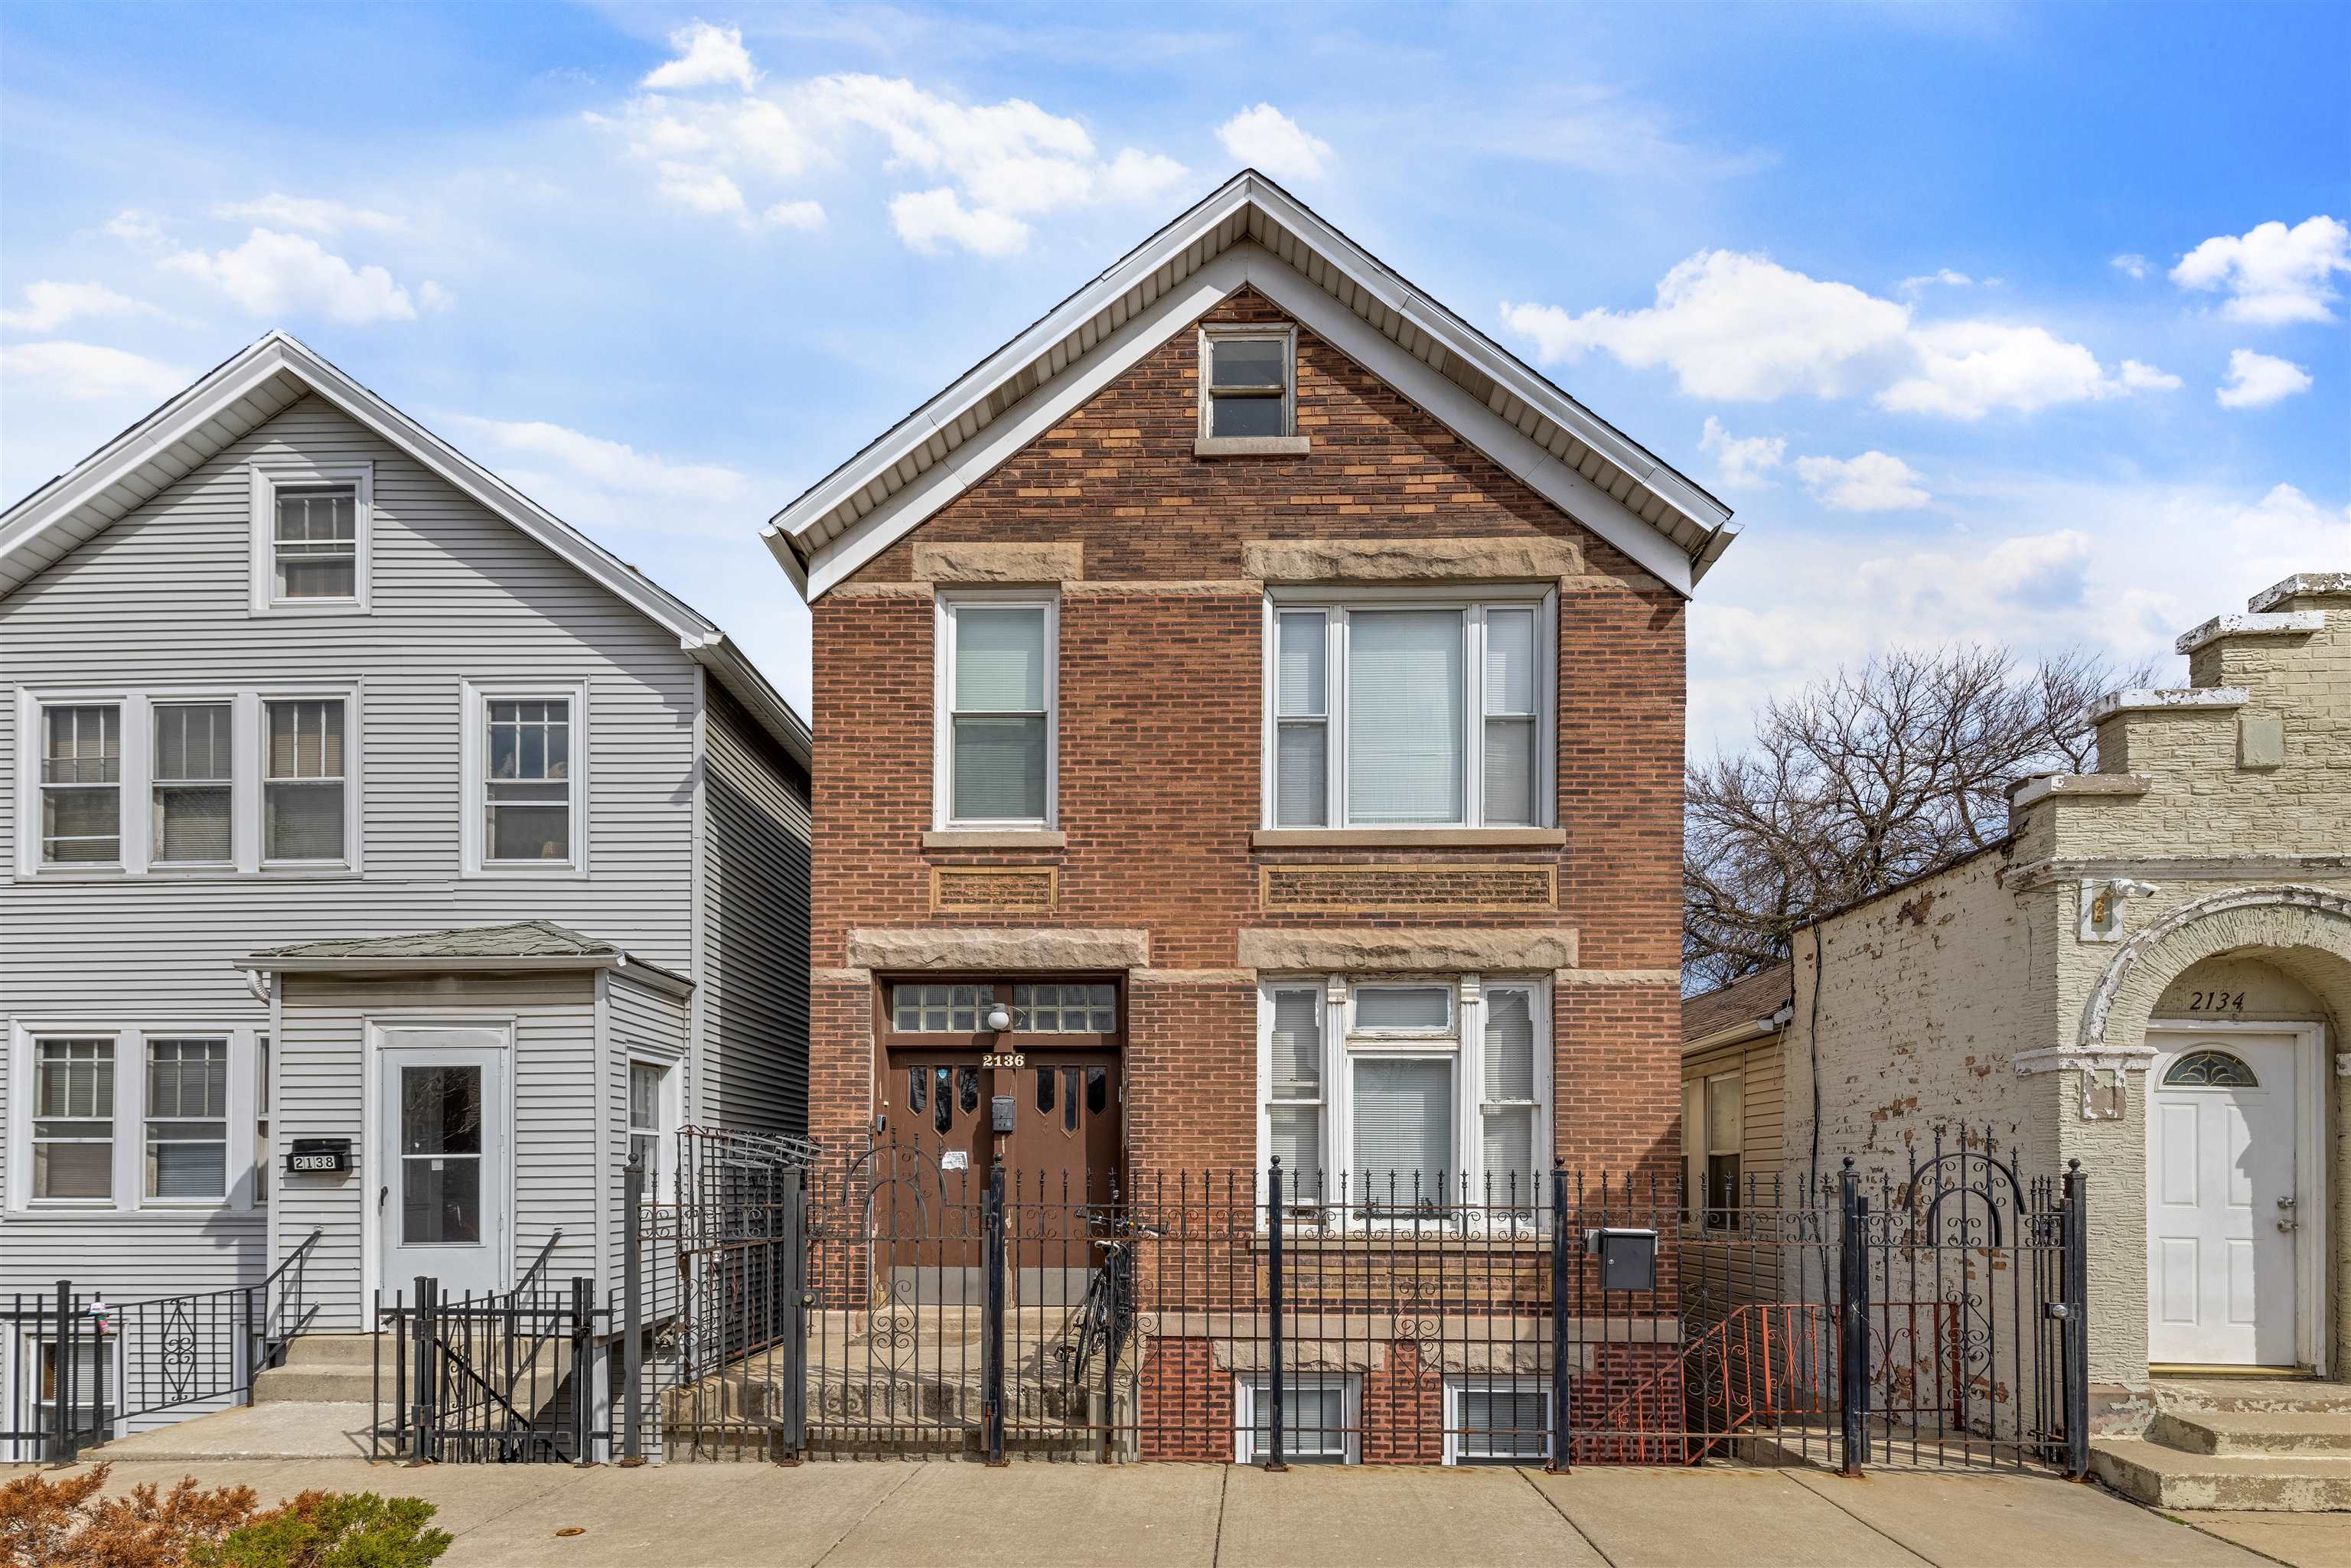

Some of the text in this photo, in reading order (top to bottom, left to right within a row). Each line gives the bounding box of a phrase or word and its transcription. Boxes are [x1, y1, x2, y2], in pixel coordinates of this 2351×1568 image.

[2190, 992, 2245, 1011] 2134
[983, 1055, 1024, 1067] 2136
[295, 1156, 334, 1169] 2138
